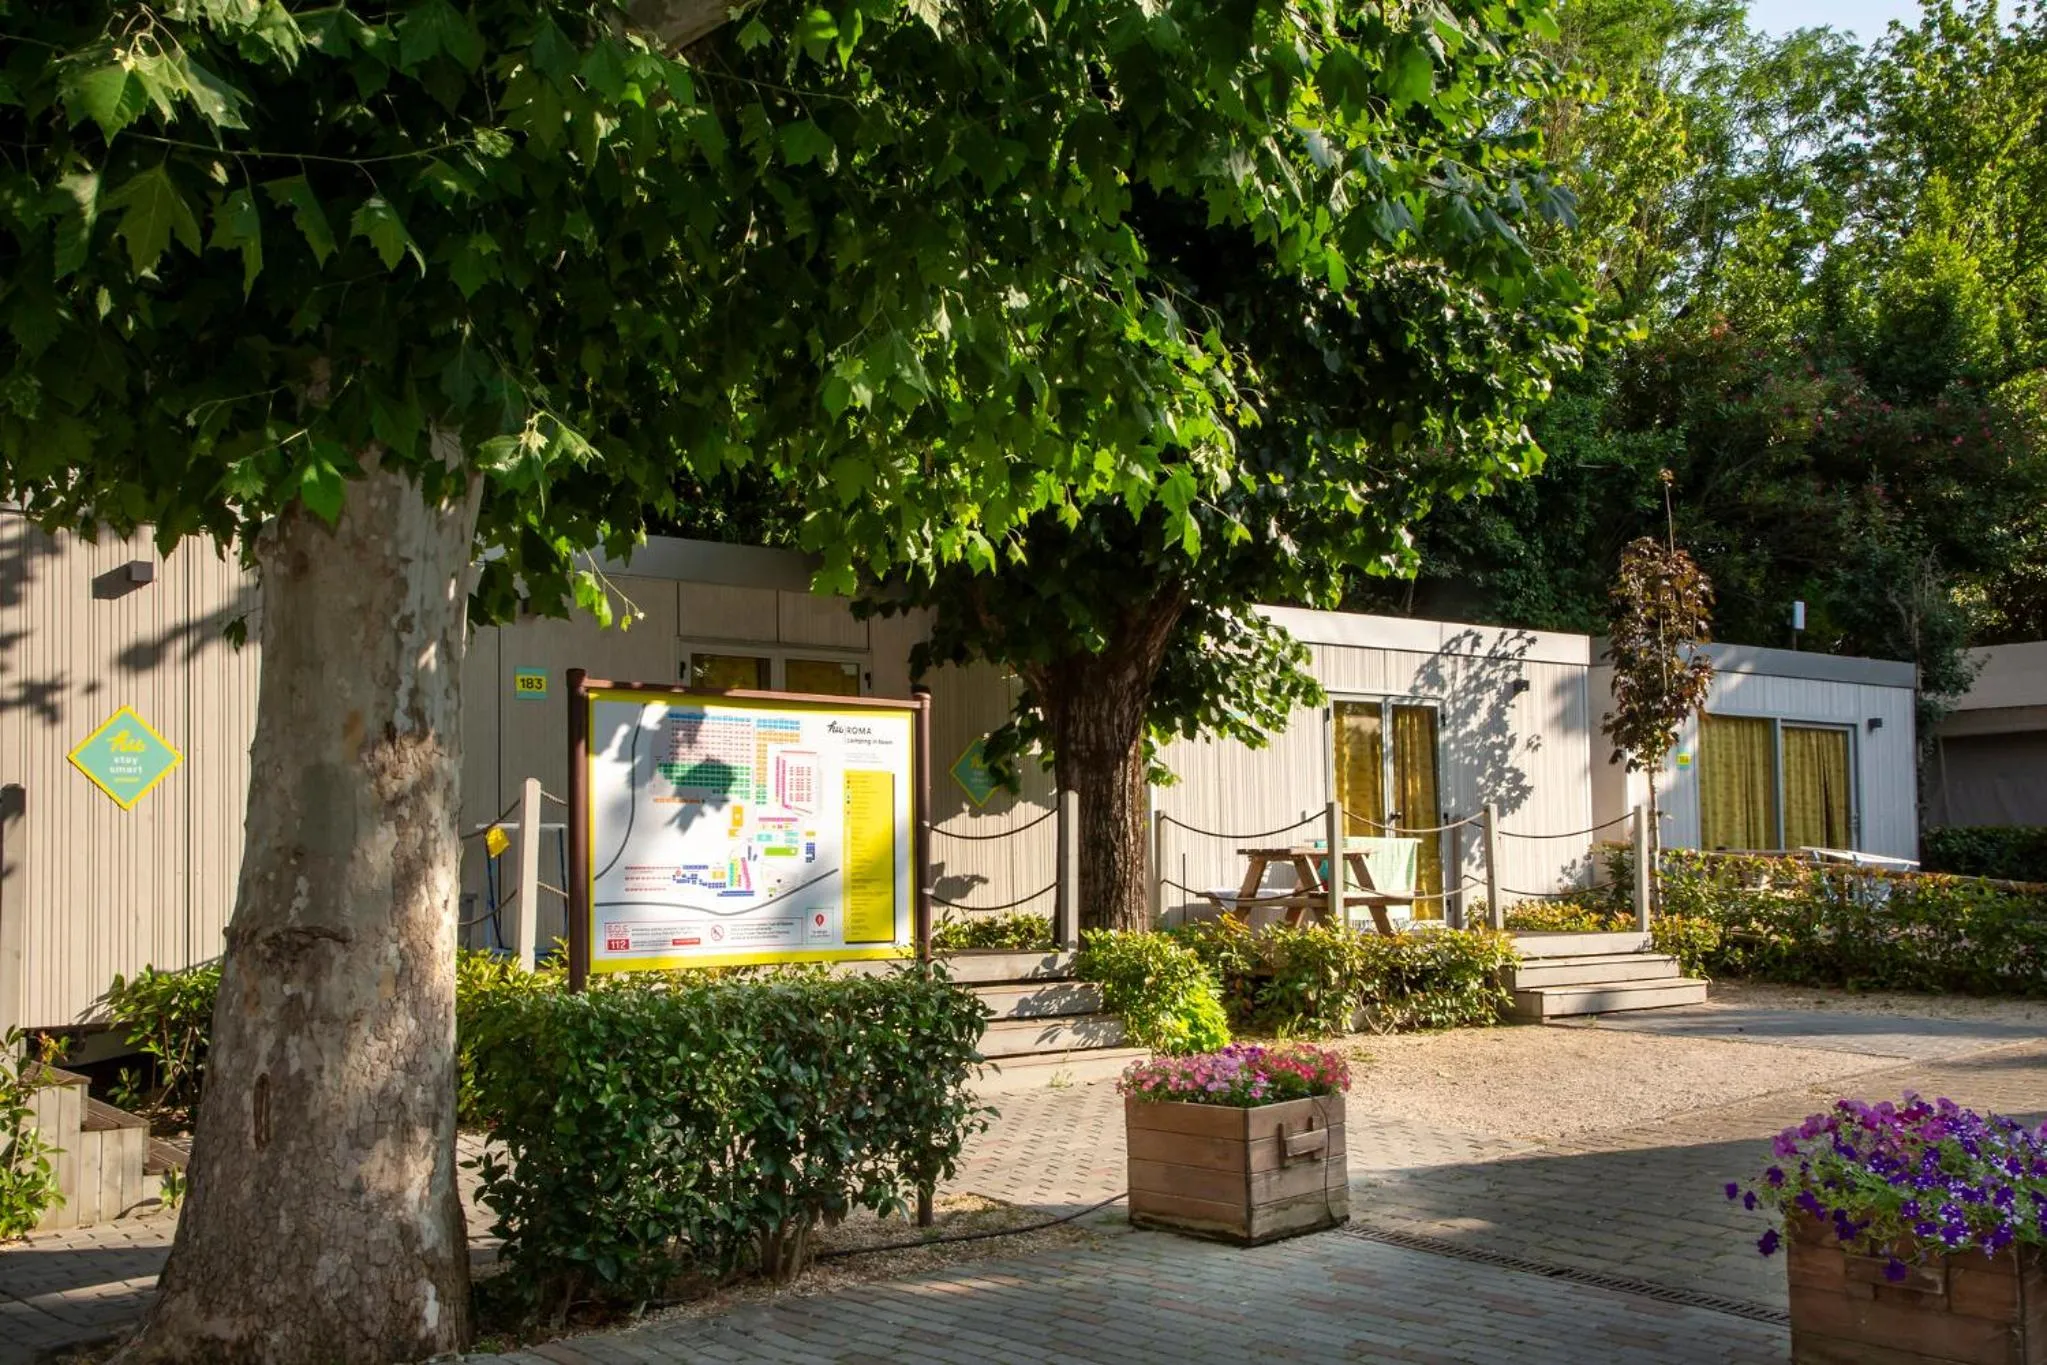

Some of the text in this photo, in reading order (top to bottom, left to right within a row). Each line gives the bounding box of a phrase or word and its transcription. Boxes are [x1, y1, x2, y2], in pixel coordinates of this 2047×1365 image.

[520, 677, 543, 690] 183
[846, 726, 872, 735] ROMA
[109, 765, 143, 775] smart
[610, 940, 627, 950] 112
